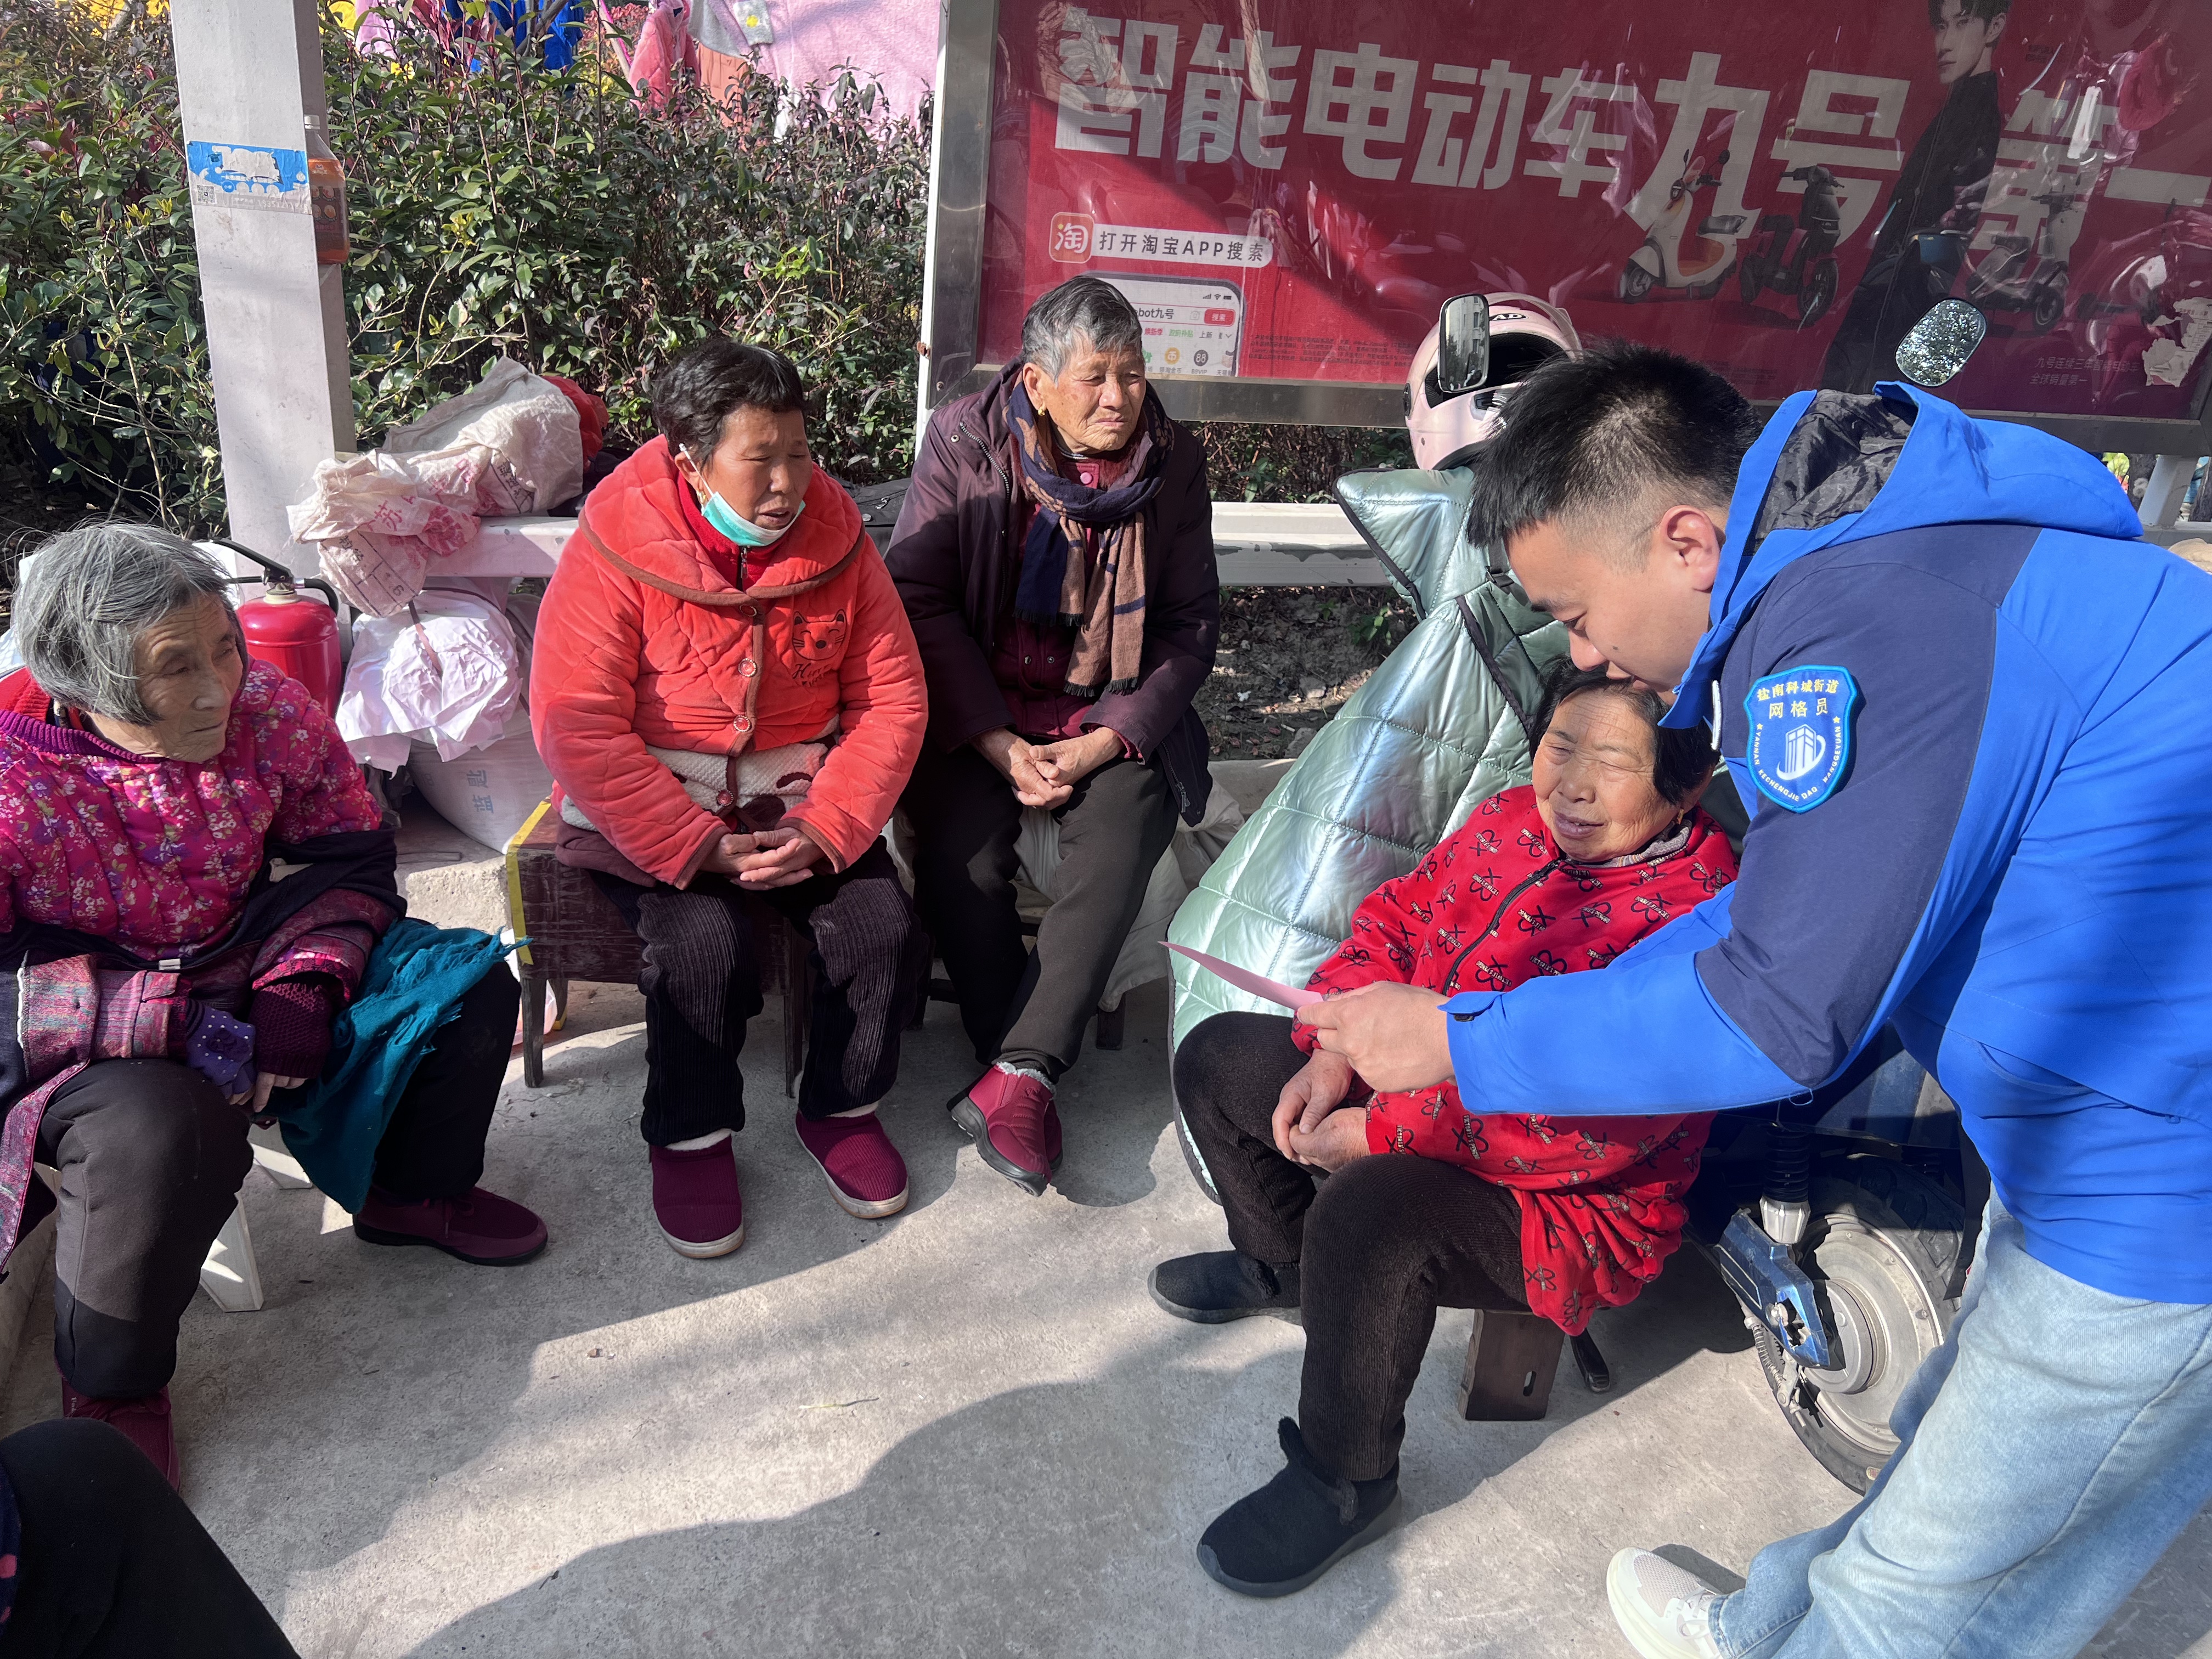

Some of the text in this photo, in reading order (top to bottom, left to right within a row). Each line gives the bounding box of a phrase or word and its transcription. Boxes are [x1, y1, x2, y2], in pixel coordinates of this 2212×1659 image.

[1054, 223, 1088, 253] 淘
[1099, 231, 1264, 262] 打开淘宝APP搜索
[1136, 307, 1175, 319] bot九号
[1757, 679, 1839, 702] 盐南科城街道
[1768, 697, 1829, 719] 网格员
[1753, 731, 1818, 802] YANNAN KECHENGJIE DAO
[1822, 726, 1841, 783] WANGGEYUAN
